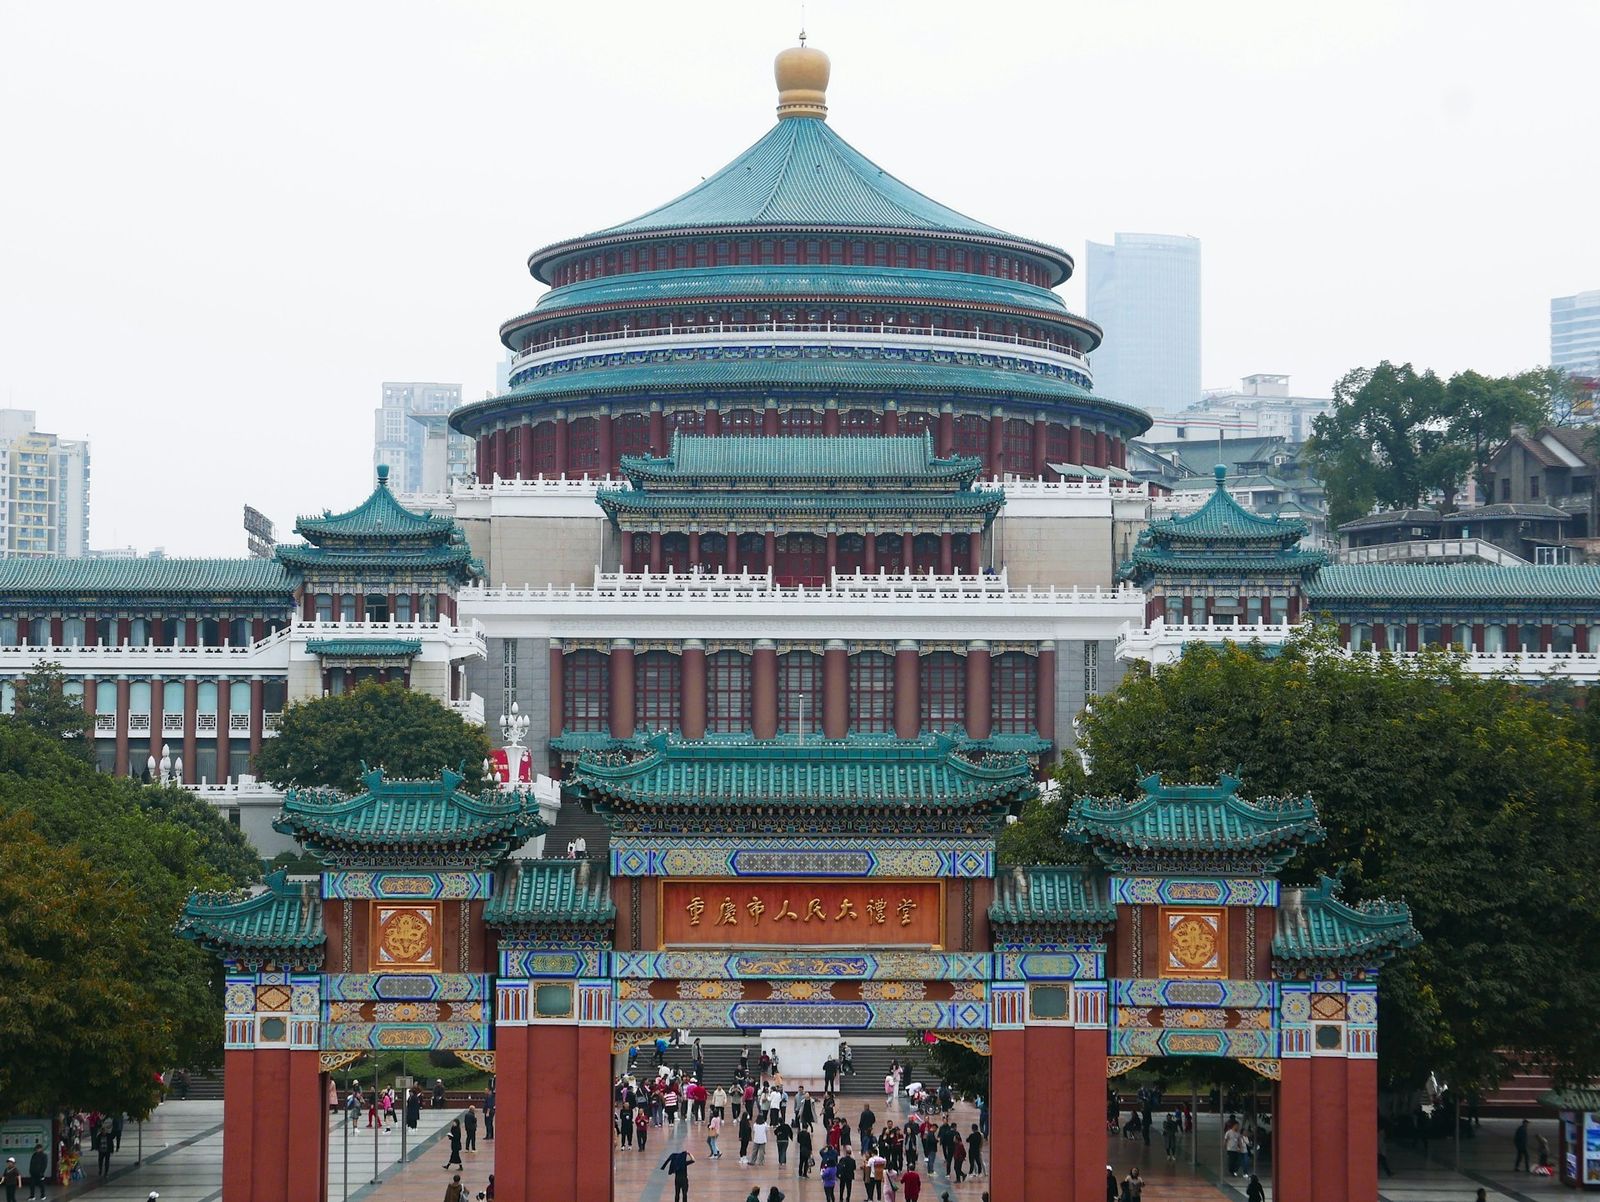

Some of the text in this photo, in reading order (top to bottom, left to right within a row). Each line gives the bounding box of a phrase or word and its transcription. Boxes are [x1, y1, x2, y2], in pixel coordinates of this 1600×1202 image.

[686, 896, 917, 926] 重慶市人民大禮堂
